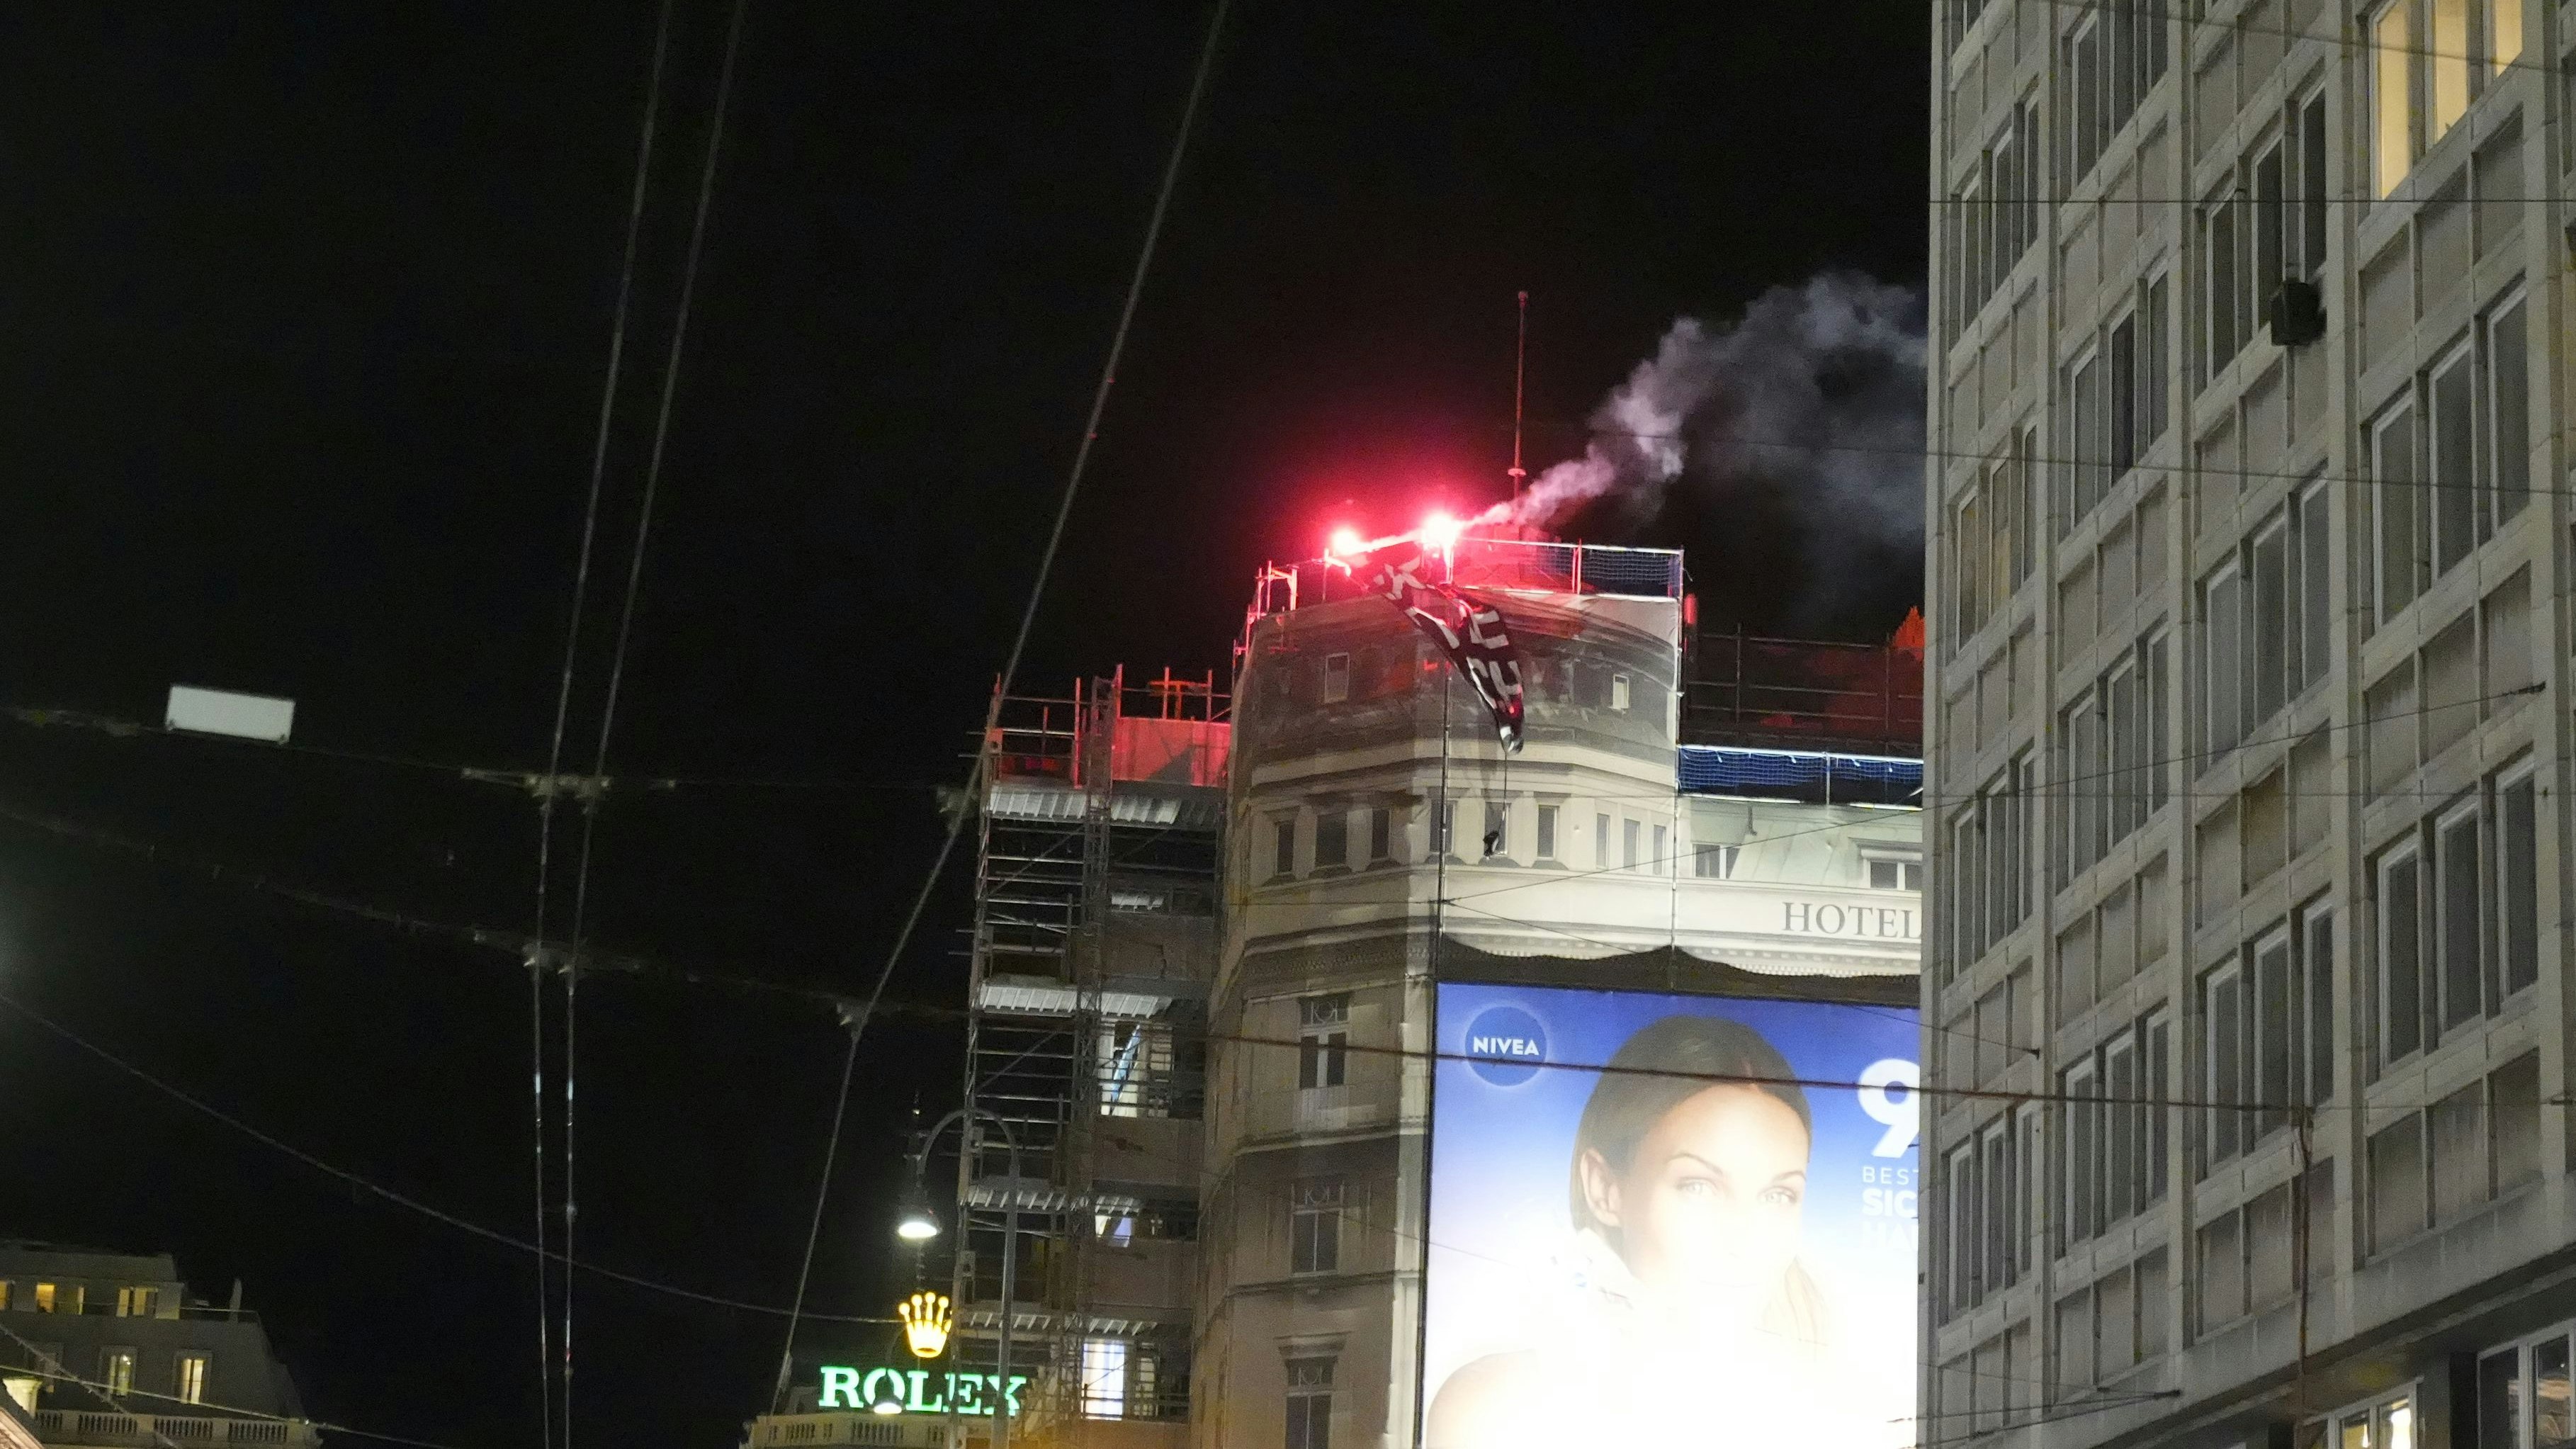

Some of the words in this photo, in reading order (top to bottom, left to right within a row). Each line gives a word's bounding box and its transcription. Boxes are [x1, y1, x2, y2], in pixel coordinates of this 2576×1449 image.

[1783, 901, 1921, 939] HOTEL
[1473, 1036, 1540, 1056] NIVEA
[818, 1365, 1027, 1416] ROLEX
